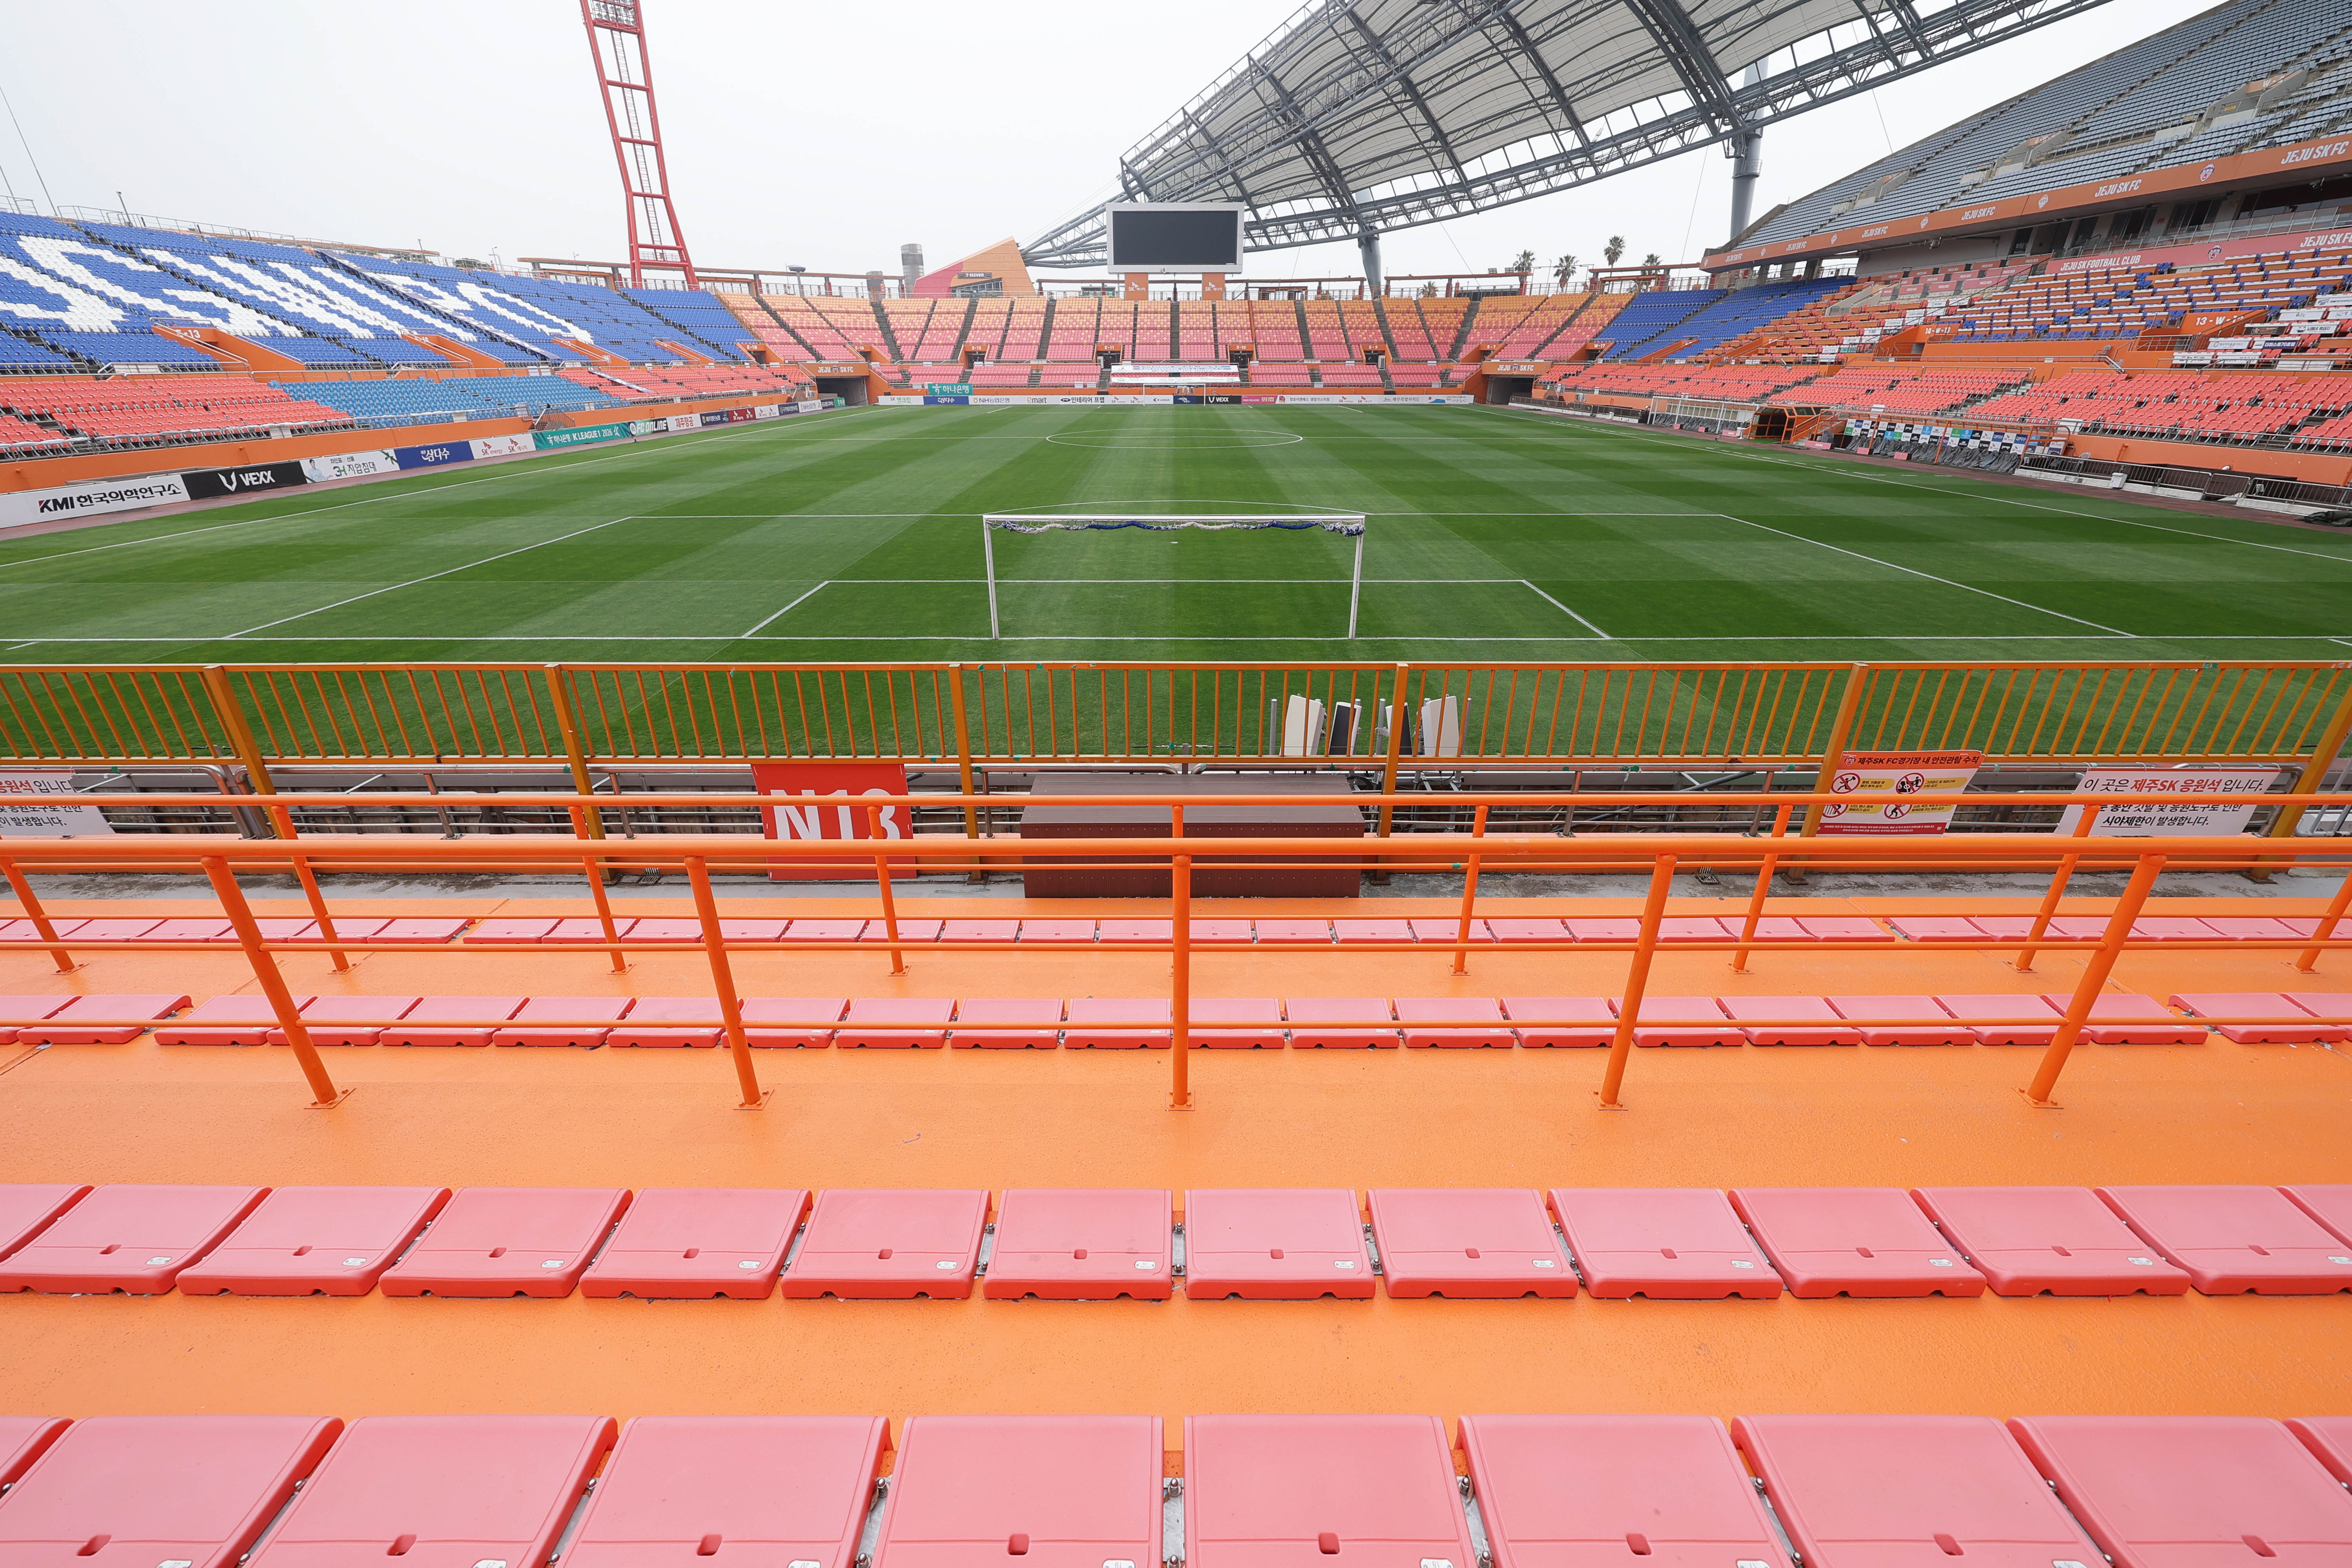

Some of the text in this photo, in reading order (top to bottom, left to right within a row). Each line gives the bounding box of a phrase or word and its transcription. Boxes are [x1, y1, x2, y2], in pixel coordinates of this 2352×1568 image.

[2281, 141, 2350, 164] JEJU SK FC
[2095, 180, 2142, 197] JEJU SK FC
[1961, 206, 1996, 220] JEJU SK FC
[1862, 226, 1888, 238] JEJU SK FC
[1786, 243, 1797, 251] JEJU
[2300, 235, 2326, 247] JEJU
[2328, 233, 2342, 246] SK
[2060, 255, 2141, 271] JEJU SK FOOTBALL CLUB
[942, 385, 969, 394] 하나은행
[636, 419, 667, 434] FC ONLINE
[675, 418, 693, 428] 제주항공
[601, 429, 612, 437] 2026
[421, 448, 450, 462] 삼다수
[348, 462, 377, 475] 지압침대
[239, 470, 276, 486] VEXX
[39, 484, 182, 514] KMI 한국의학연구소
[2084, 779, 2264, 792] 이 곳은 제주SK 응원석 입니다.
[770, 788, 900, 839] N13
[9, 817, 67, 826] 발생합니다.
[2103, 816, 2209, 826] 시야제한이 발생합니다.
